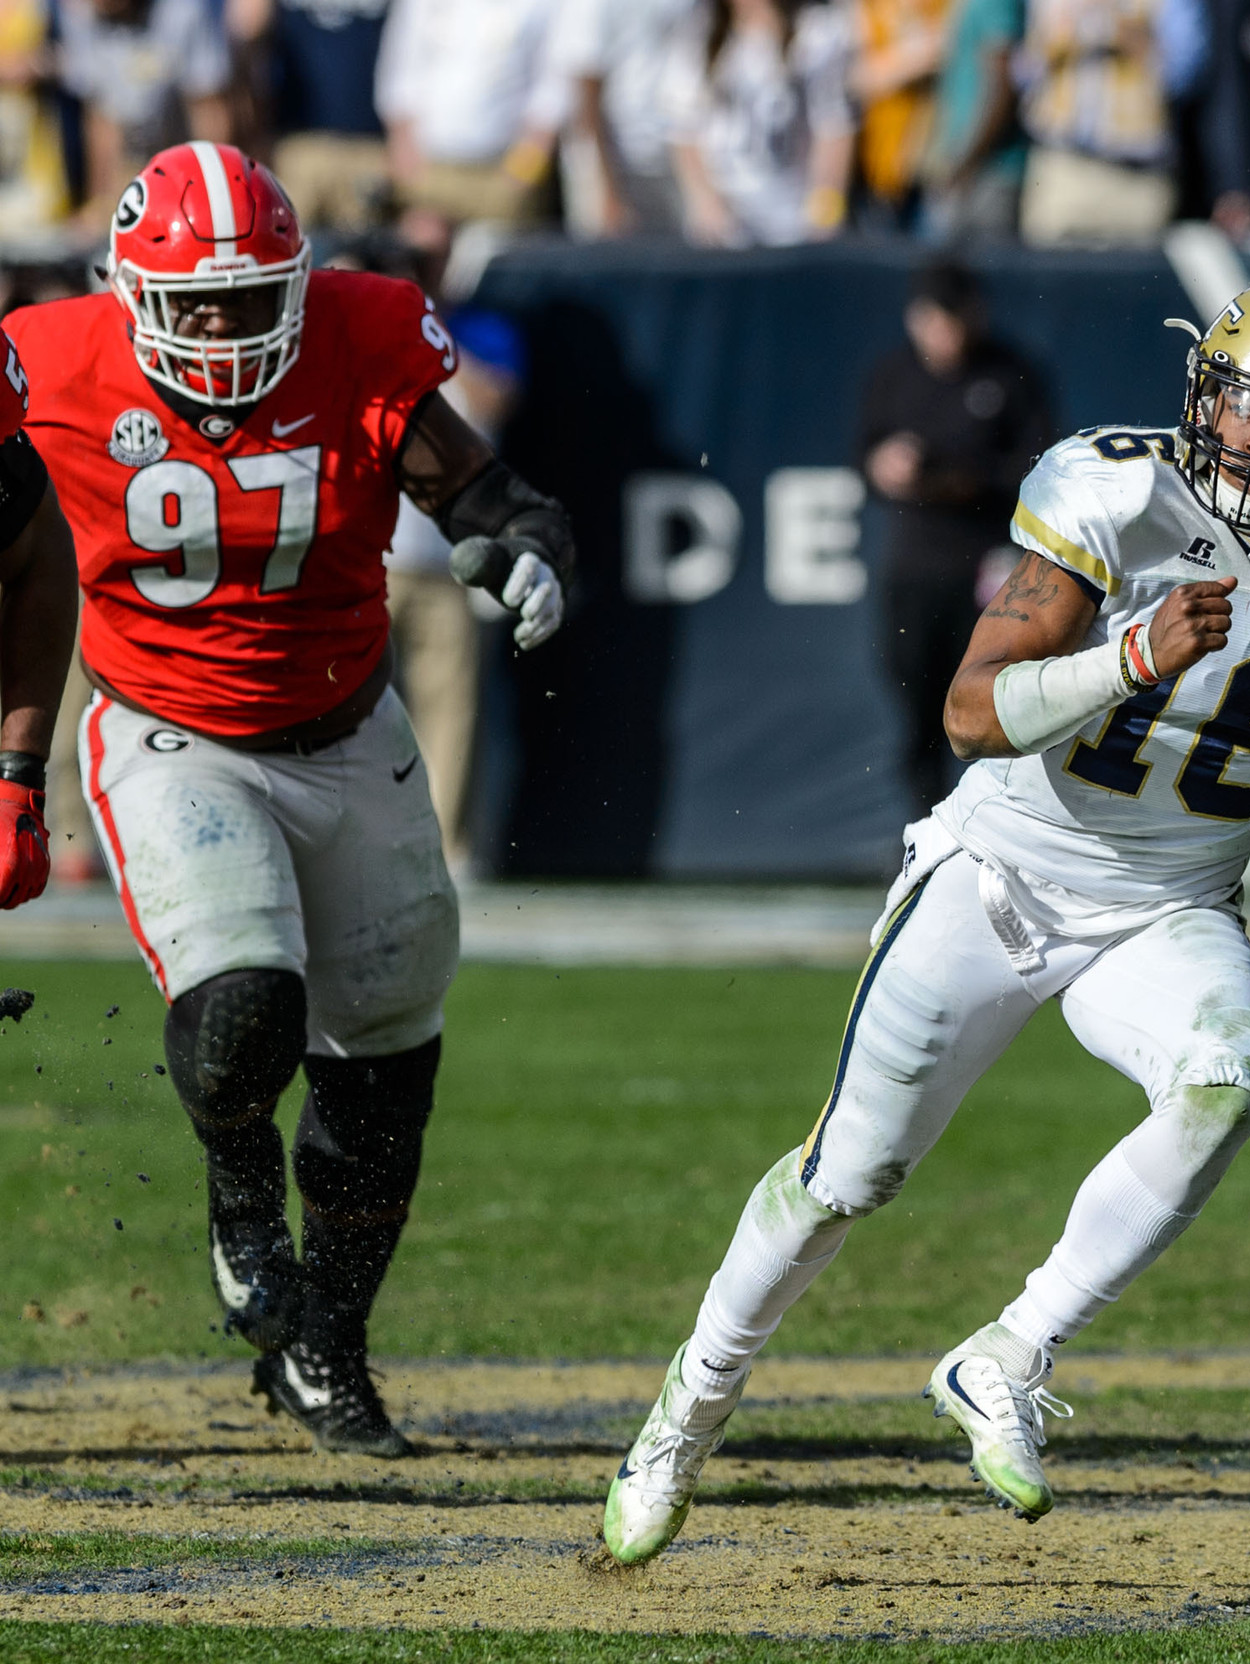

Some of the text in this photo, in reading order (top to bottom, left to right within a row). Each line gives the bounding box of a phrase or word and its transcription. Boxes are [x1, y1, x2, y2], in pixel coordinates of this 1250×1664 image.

[115, 410, 160, 453] SEC
[125, 445, 323, 608] 97
[620, 465, 868, 606] DE
[1178, 551, 1217, 571] RUSSELL
